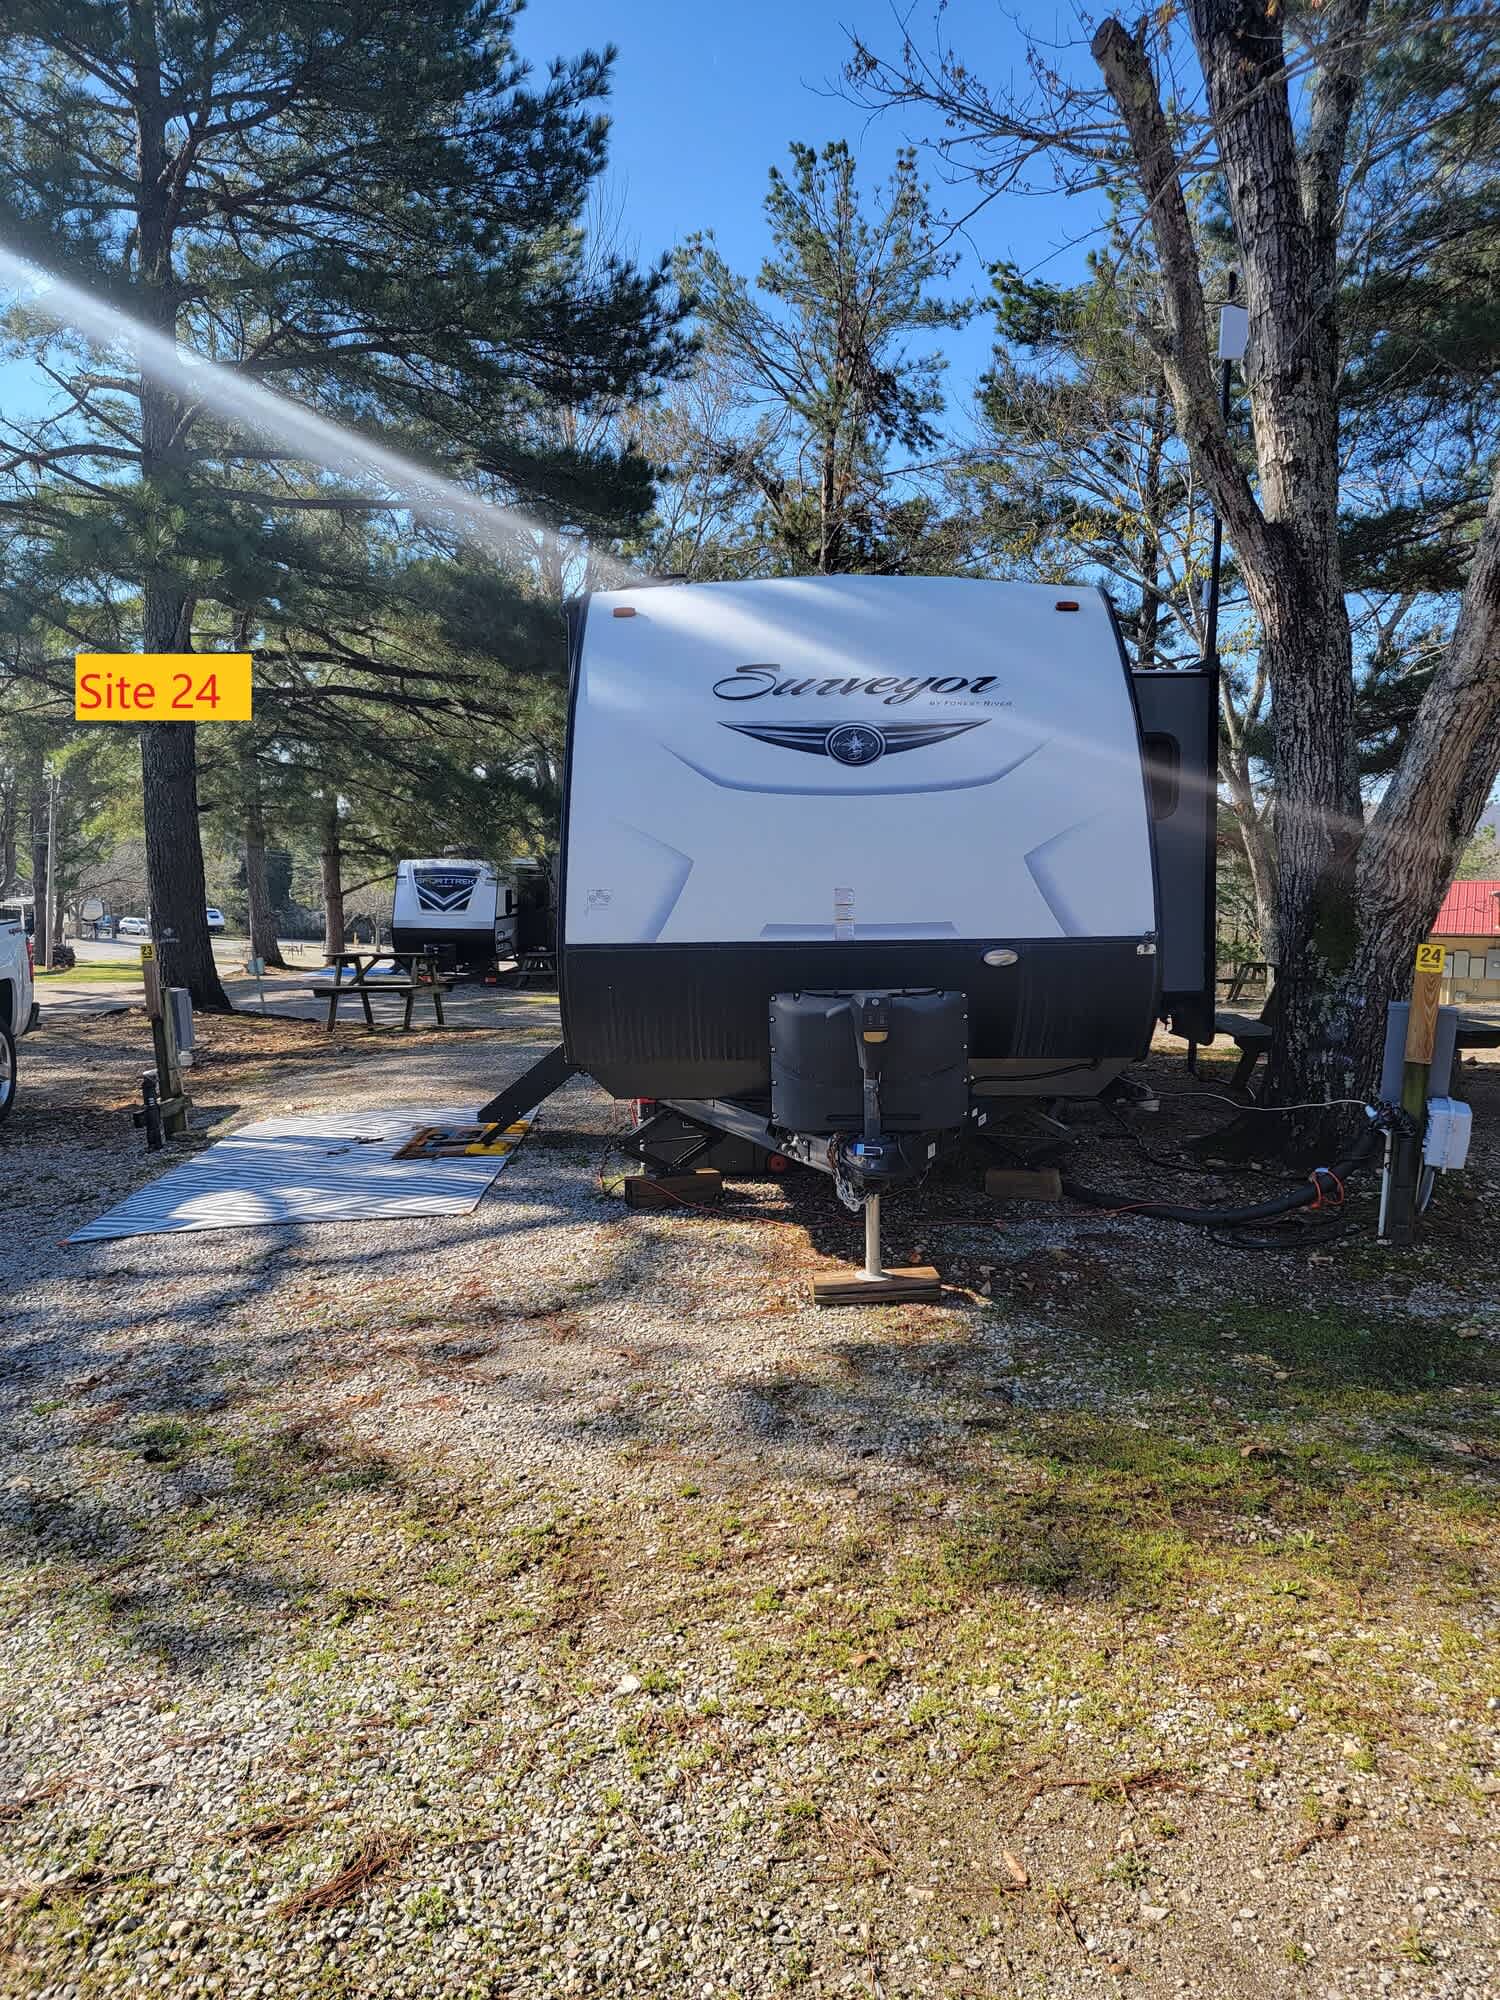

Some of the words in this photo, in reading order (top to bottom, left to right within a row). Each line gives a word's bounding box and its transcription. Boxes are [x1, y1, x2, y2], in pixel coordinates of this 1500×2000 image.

[712, 663, 998, 705] Surveyor
[141, 945, 153, 956] 23
[1420, 947, 1442, 963] 24
